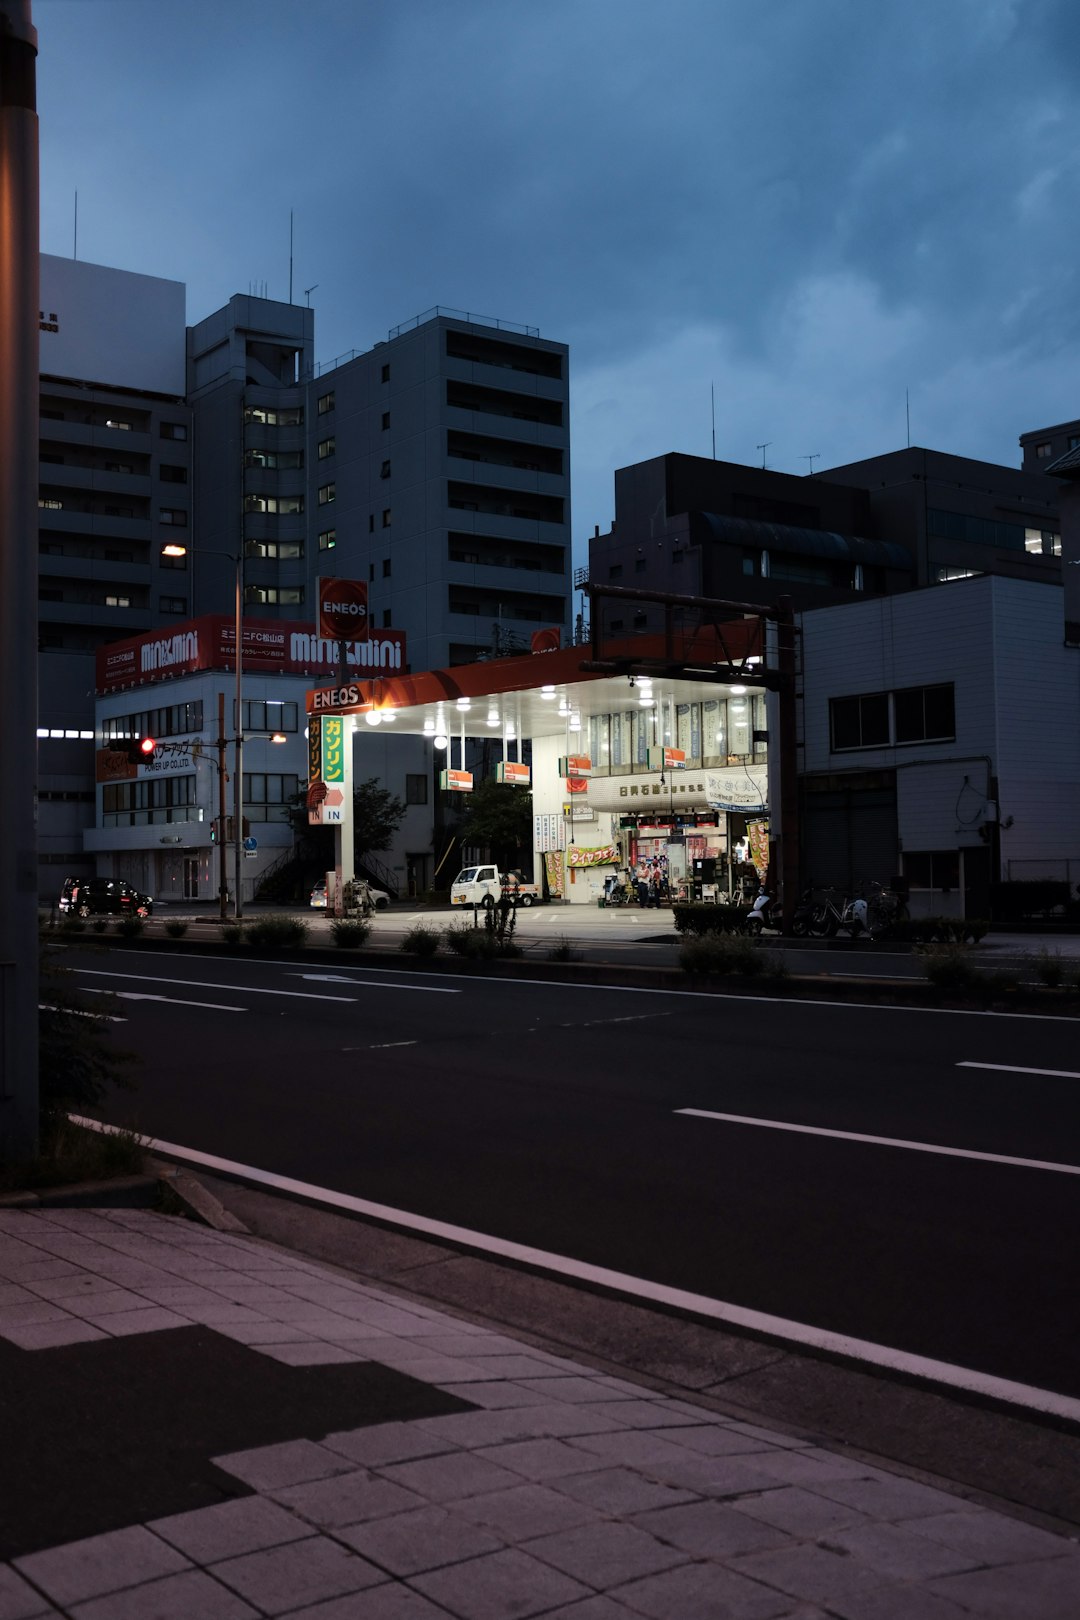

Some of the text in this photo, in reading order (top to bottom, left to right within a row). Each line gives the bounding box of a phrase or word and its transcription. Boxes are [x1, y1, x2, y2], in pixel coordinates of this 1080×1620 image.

[323, 601, 366, 616] ENEOS
[221, 629, 285, 644] ミニニFC松山店
[313, 685, 359, 709] ENEOS
[310, 721, 321, 781] ガソリン
[326, 720, 341, 780] ガソリン
[312, 811, 320, 820] IN
[327, 810, 341, 820] IN
